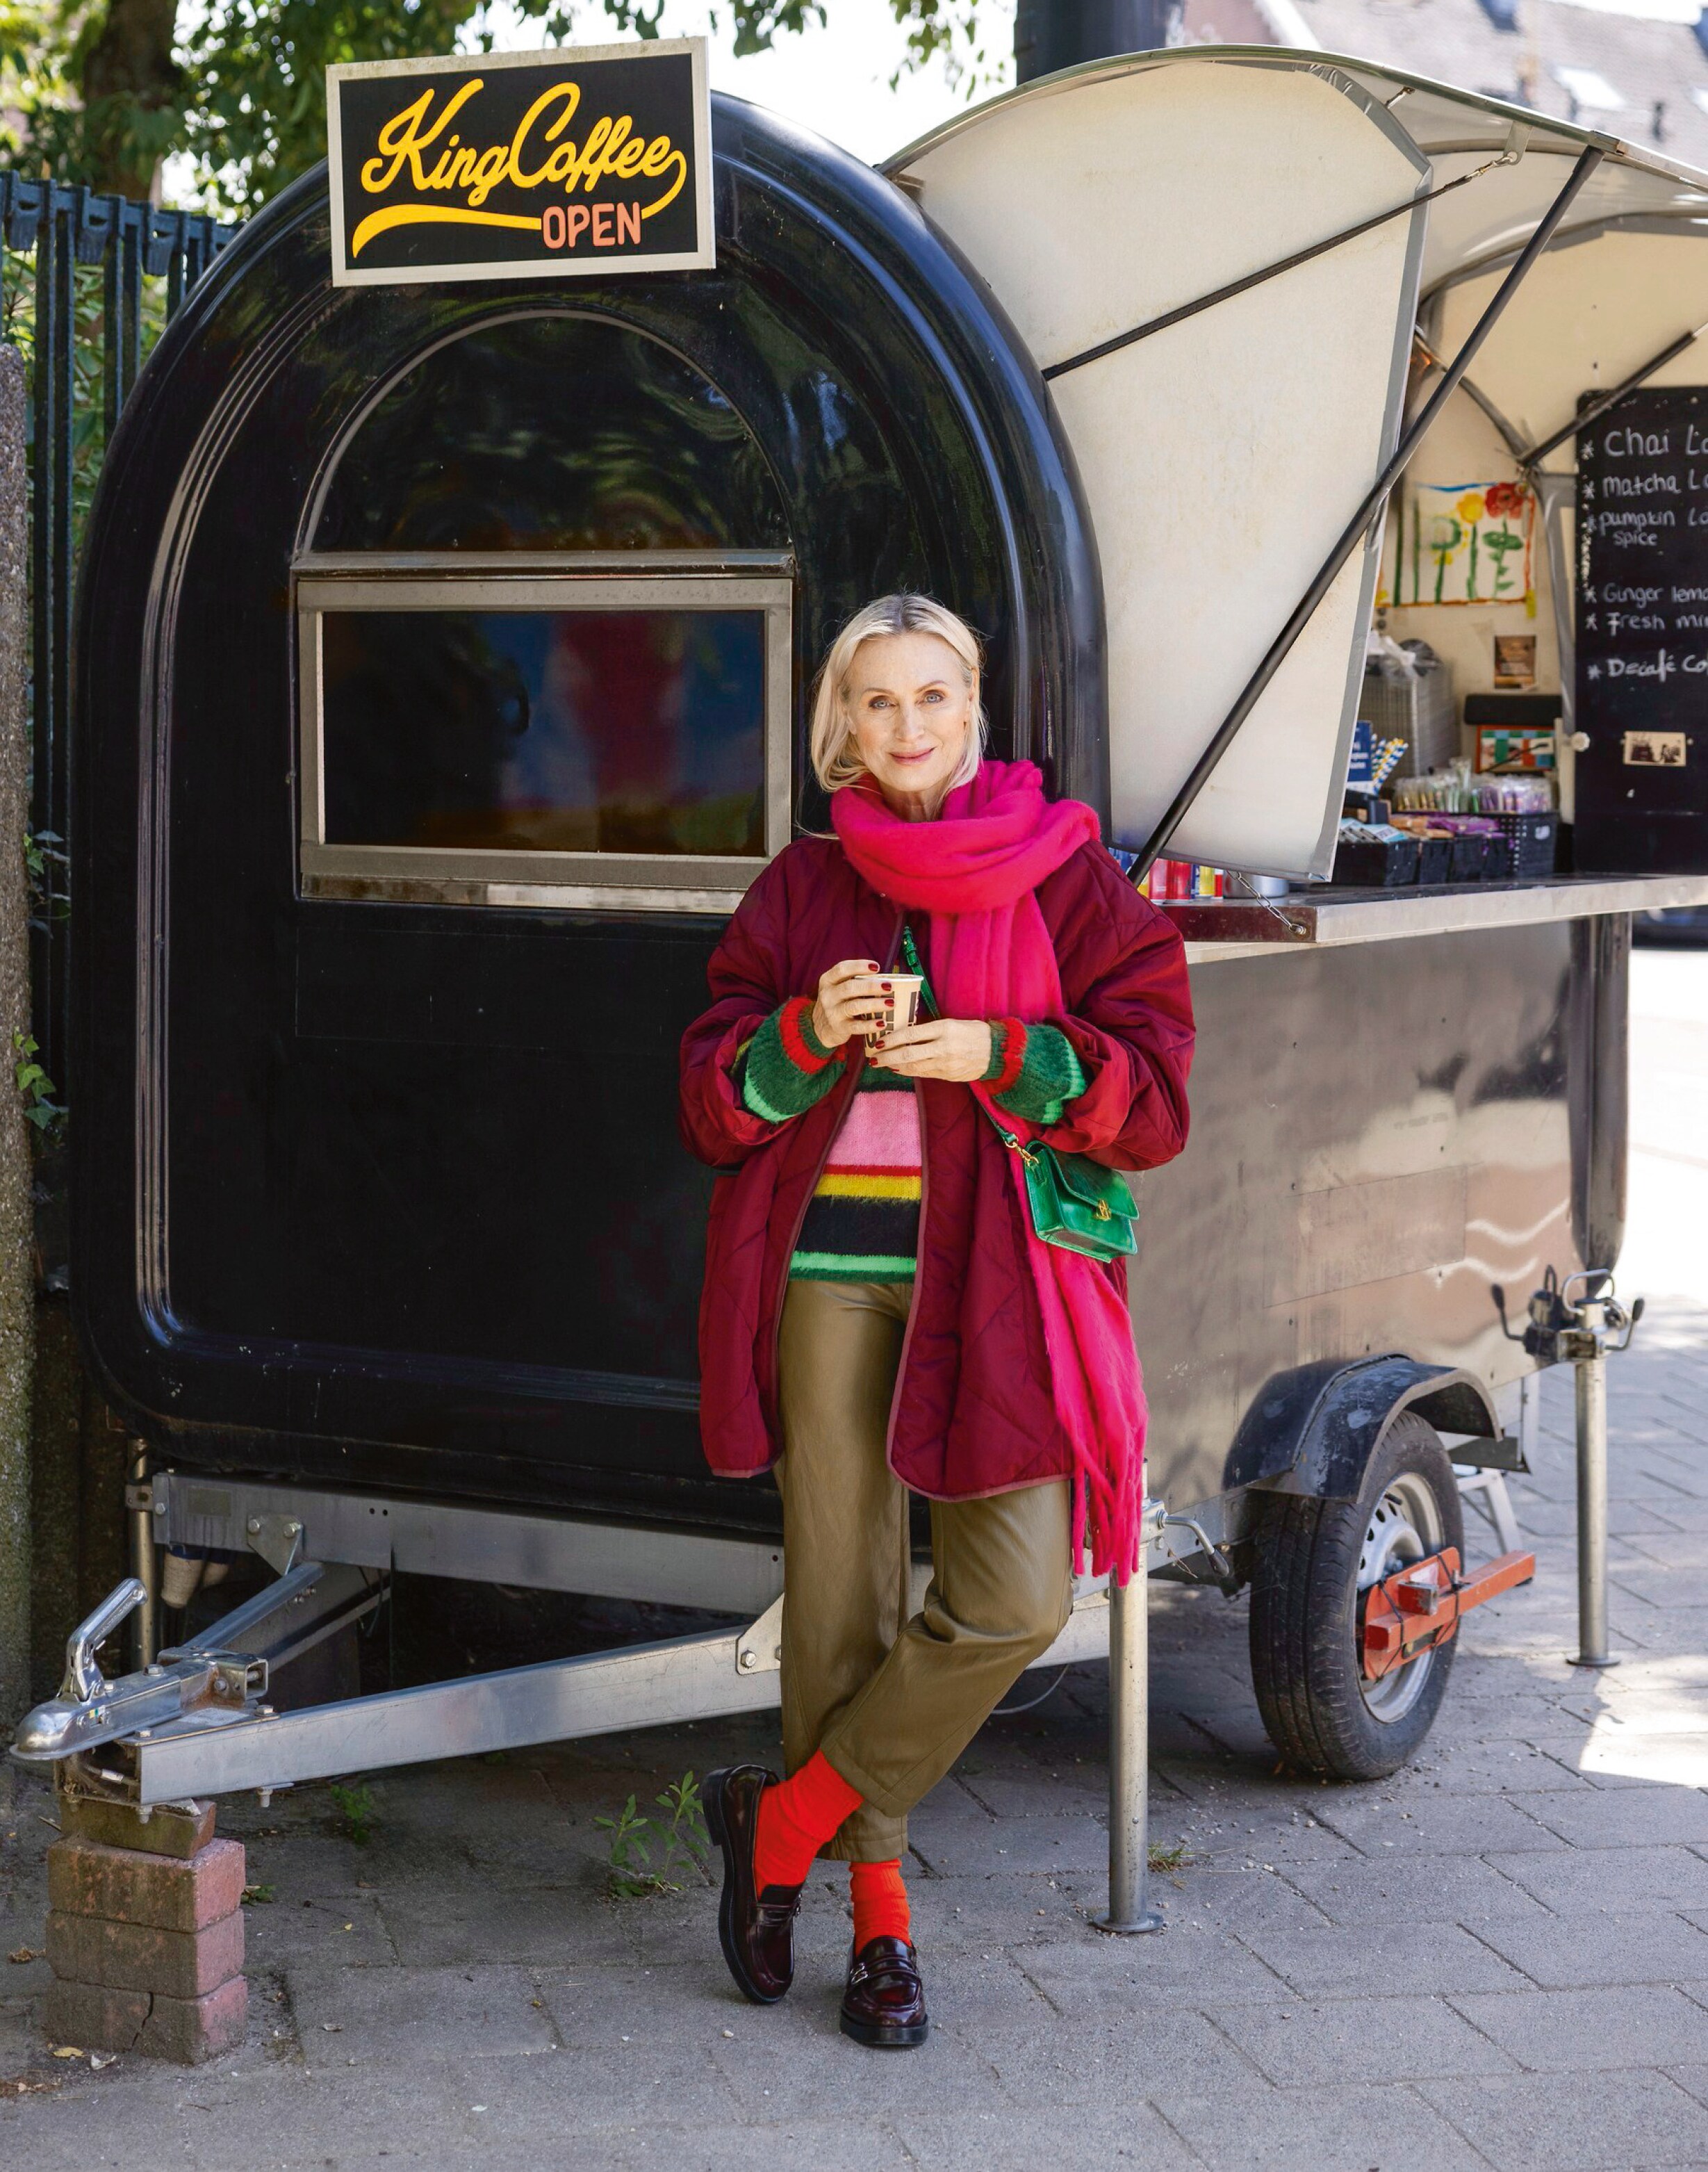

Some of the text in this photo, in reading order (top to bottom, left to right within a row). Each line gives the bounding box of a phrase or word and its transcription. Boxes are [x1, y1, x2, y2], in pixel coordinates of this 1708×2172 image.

[542, 202, 642, 250] OPEN
[1604, 426, 1669, 457] Chai
[1603, 582, 1664, 609] Ginger
[1606, 612, 1665, 636] Fresh
[1682, 648, 1708, 676] Co
